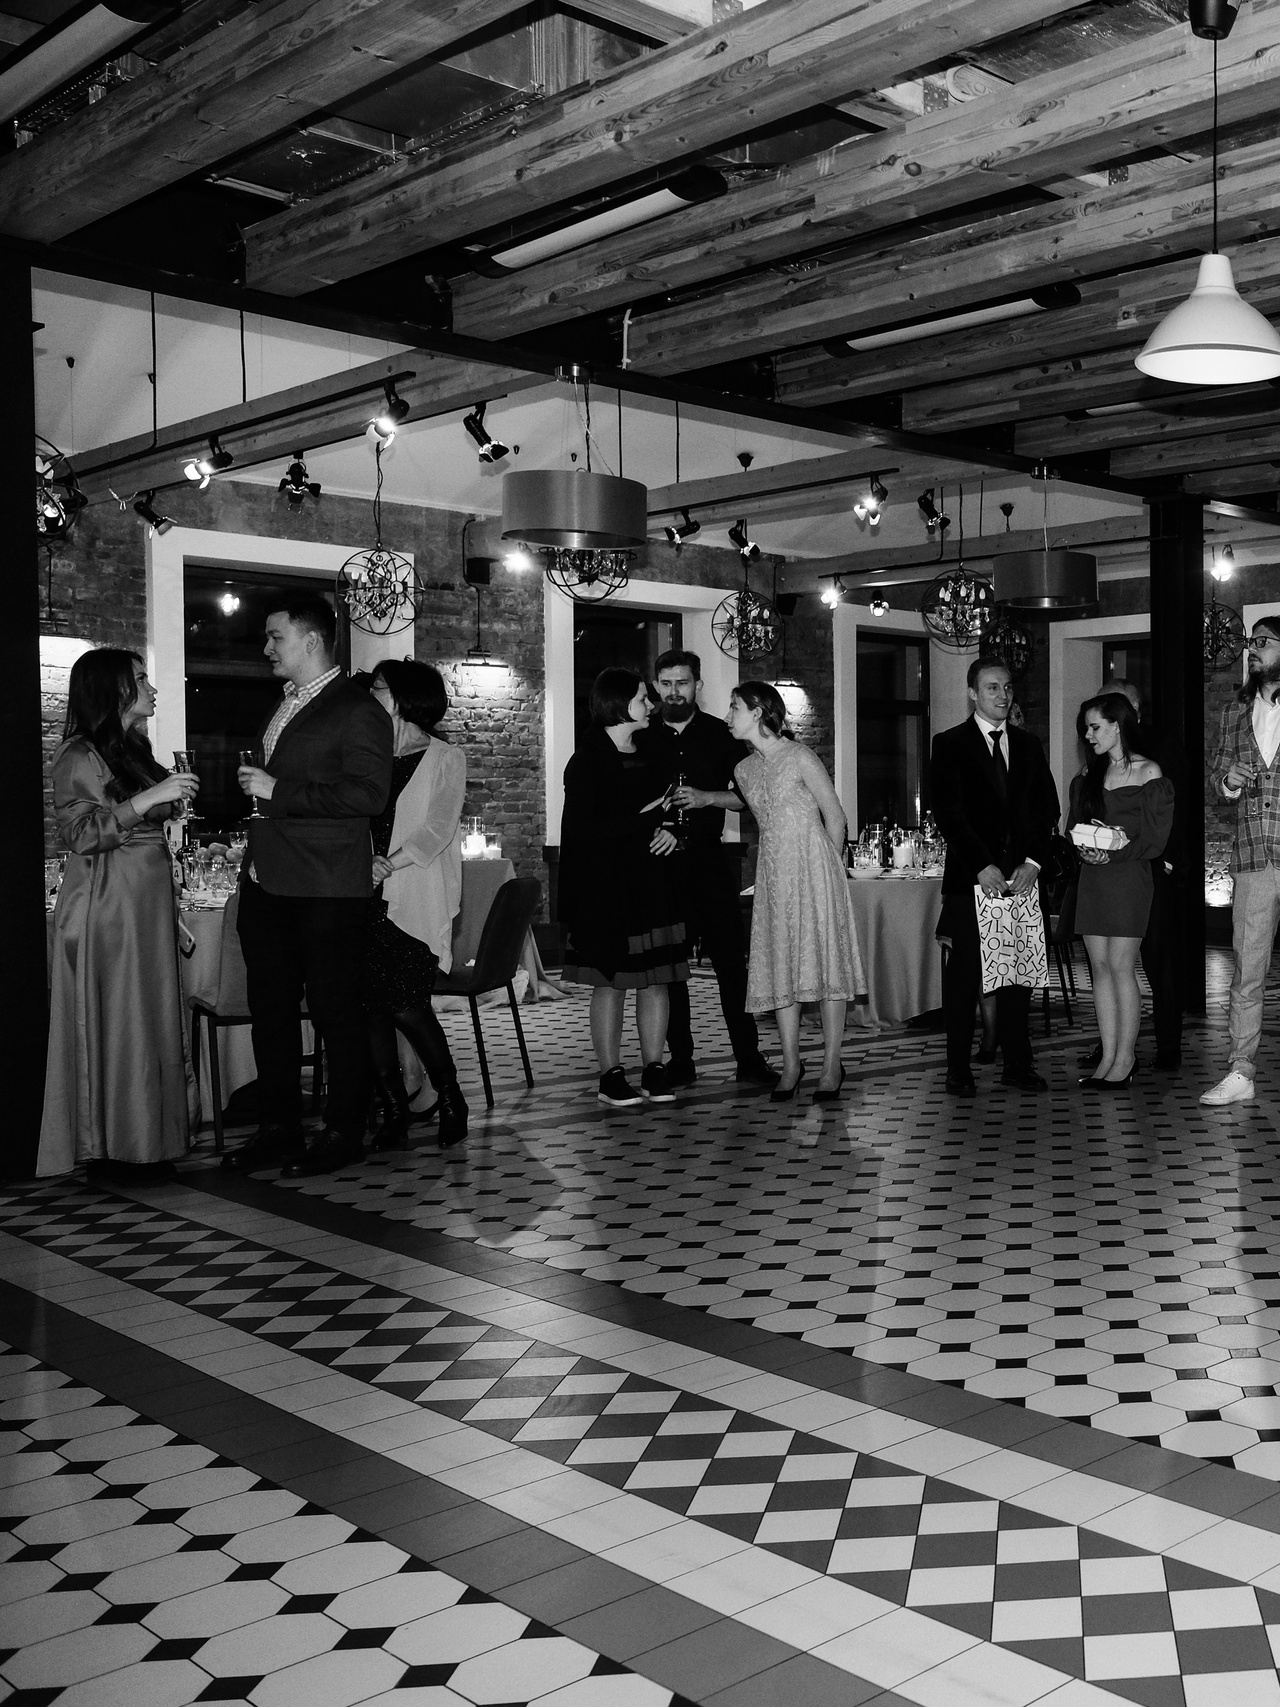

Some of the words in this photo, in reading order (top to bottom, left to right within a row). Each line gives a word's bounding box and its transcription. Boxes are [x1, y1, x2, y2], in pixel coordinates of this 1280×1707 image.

[991, 906, 1003, 919] O
[996, 920, 1003, 933] L
[988, 937, 1000, 950] O
[1026, 935, 1033, 948] E
[997, 963, 1009, 975] O
